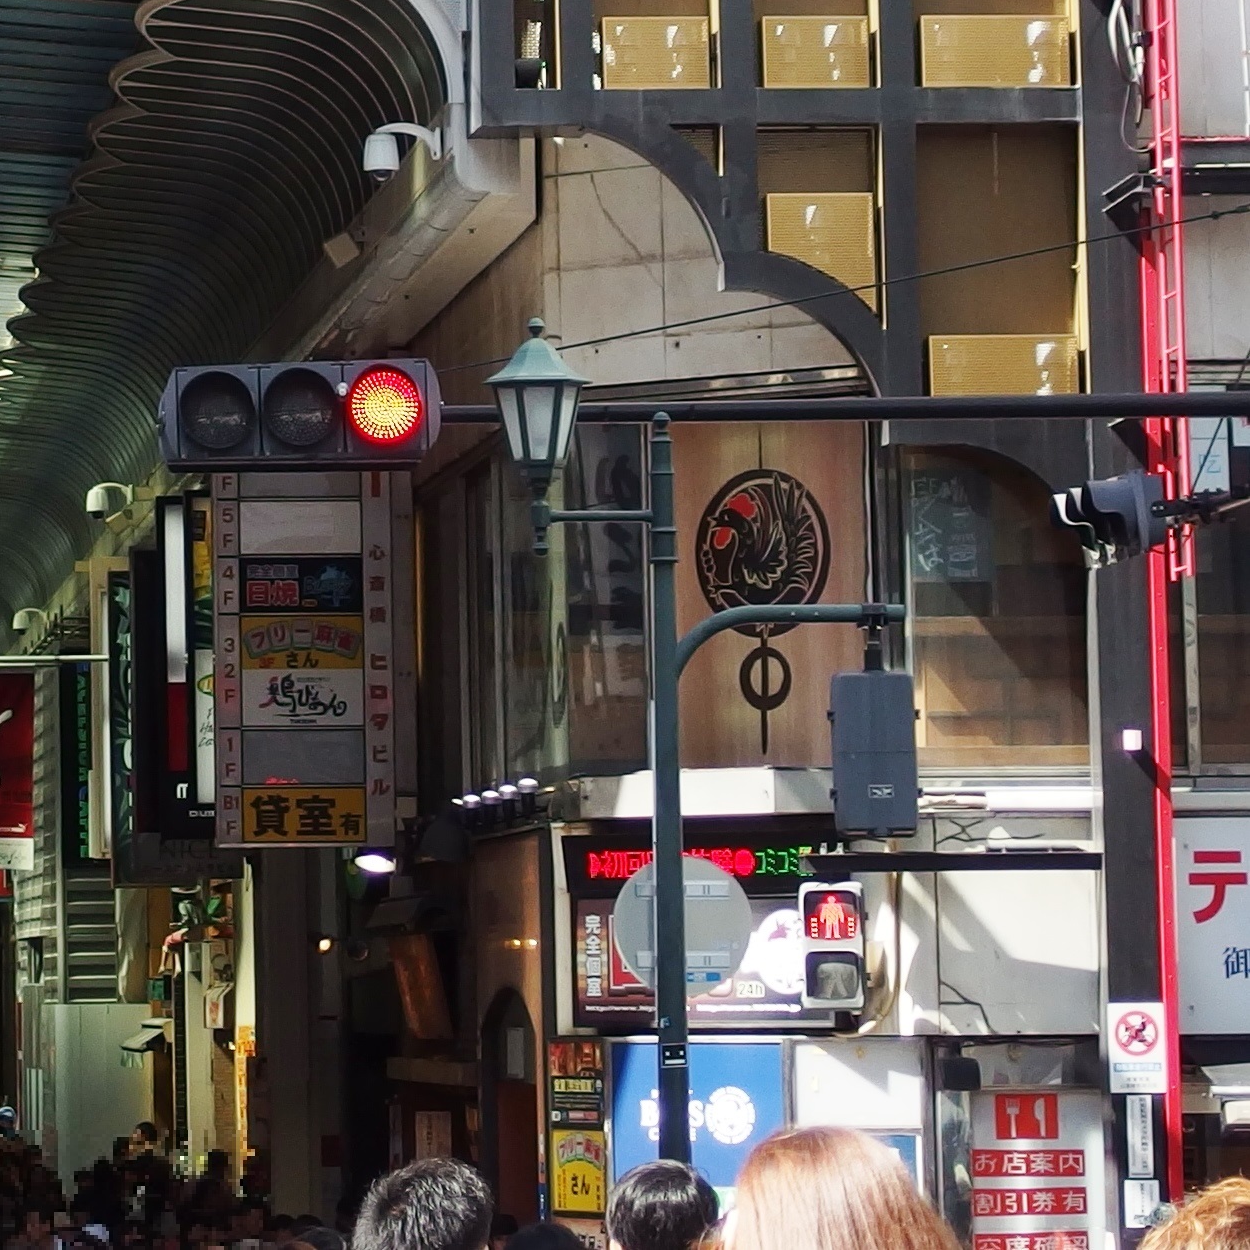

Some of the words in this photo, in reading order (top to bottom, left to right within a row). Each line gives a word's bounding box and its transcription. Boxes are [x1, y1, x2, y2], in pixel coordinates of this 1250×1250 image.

[1188, 850, 1248, 924] テ
[975, 1152, 1084, 1175] お店案内
[975, 1191, 1086, 1215] 割引券有
